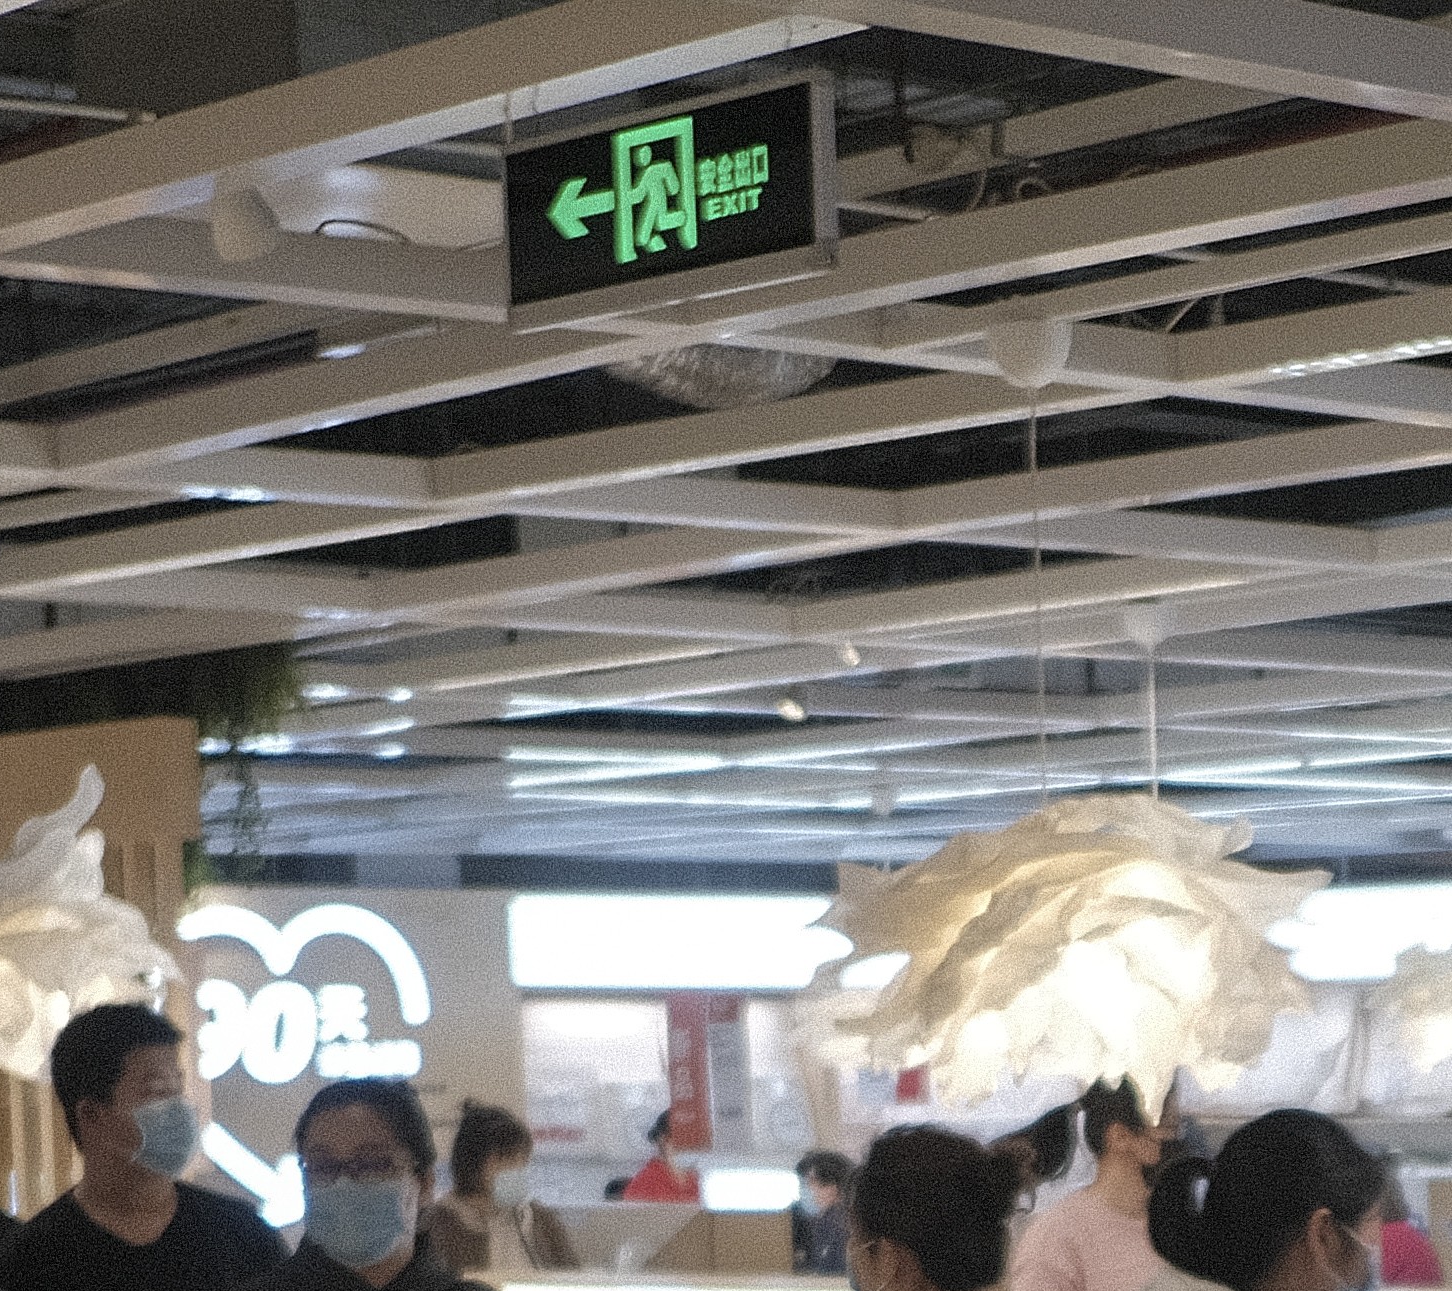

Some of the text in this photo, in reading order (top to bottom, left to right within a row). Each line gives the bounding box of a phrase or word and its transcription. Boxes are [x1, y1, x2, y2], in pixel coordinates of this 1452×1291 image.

[698, 145, 769, 196] 安全出口
[703, 189, 762, 221] EXIT
